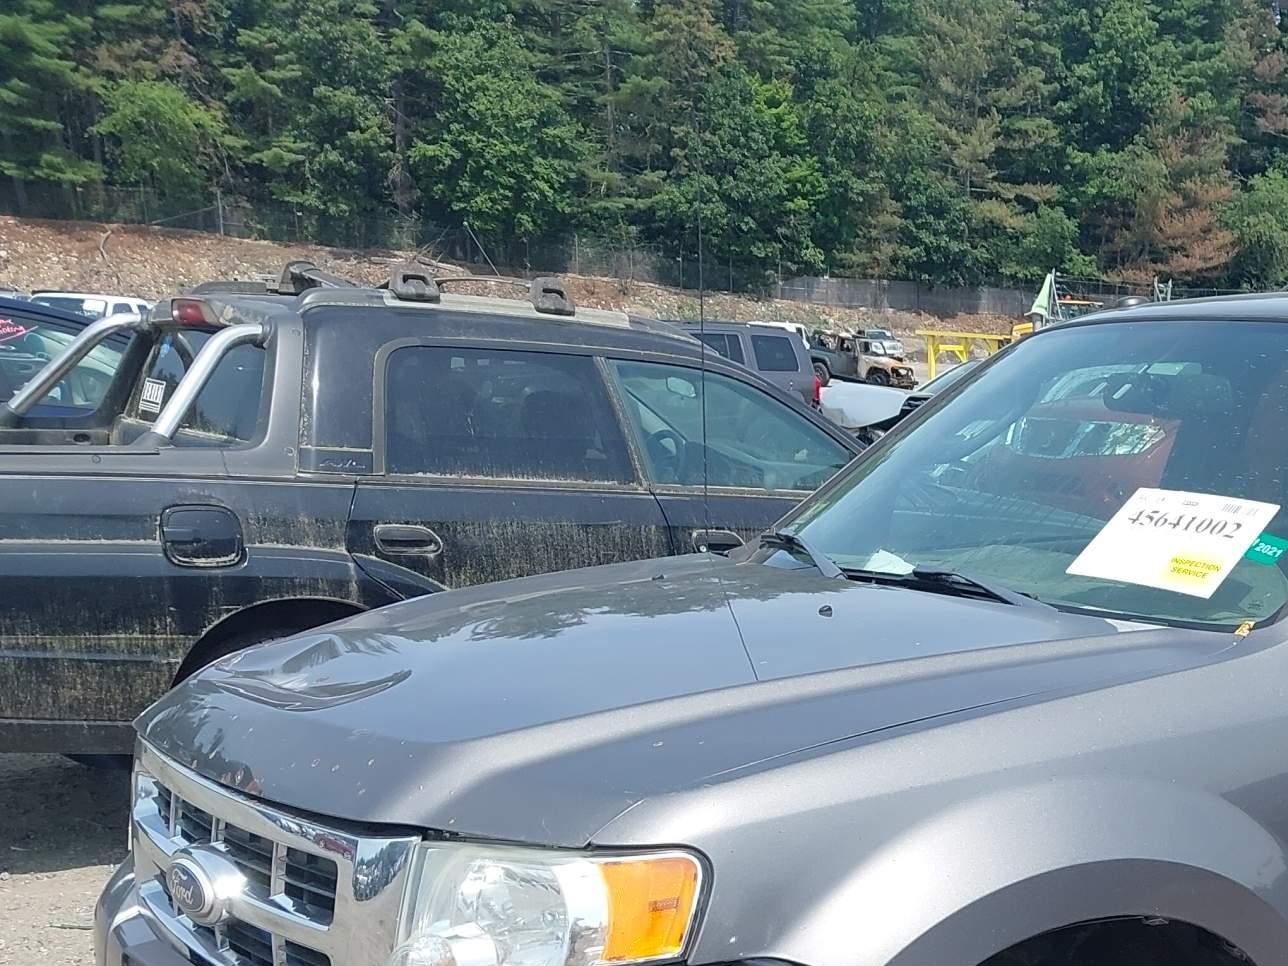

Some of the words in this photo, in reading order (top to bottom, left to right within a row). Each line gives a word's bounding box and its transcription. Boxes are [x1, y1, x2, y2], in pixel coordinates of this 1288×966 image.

[1128, 509, 1242, 539] 45641002
[1254, 542, 1284, 558] 2021
[1170, 566, 1209, 579] SERVICE
[1171, 557, 1220, 573] INSPECTION
